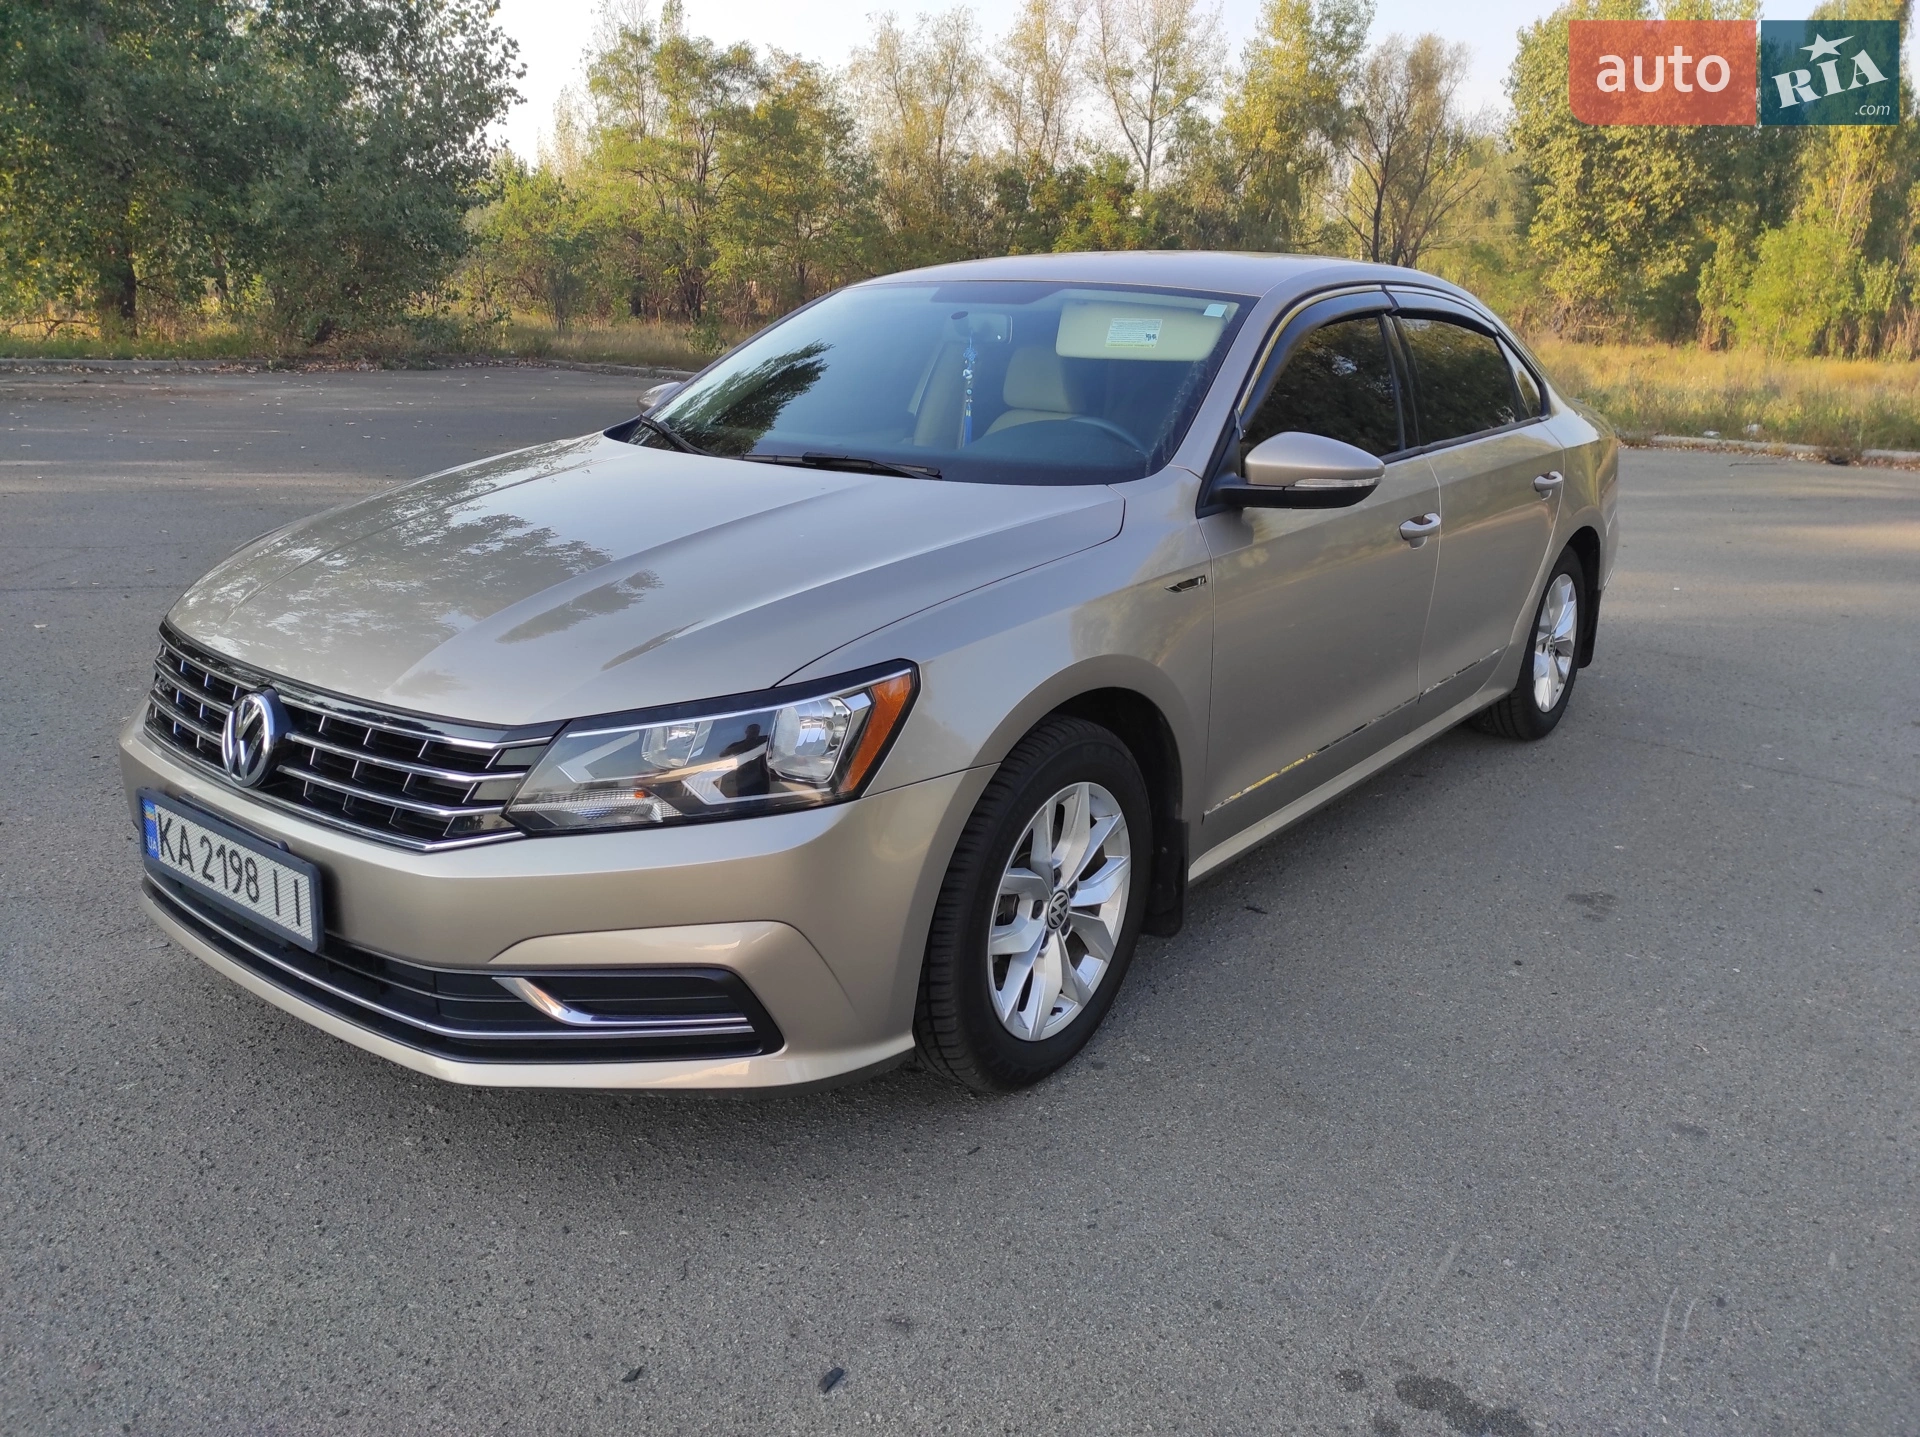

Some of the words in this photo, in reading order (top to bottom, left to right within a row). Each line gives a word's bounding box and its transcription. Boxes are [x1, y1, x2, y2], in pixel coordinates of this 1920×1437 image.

[147, 835, 158, 851] UA
[157, 812, 196, 873] KA
[199, 835, 261, 904] 2198
